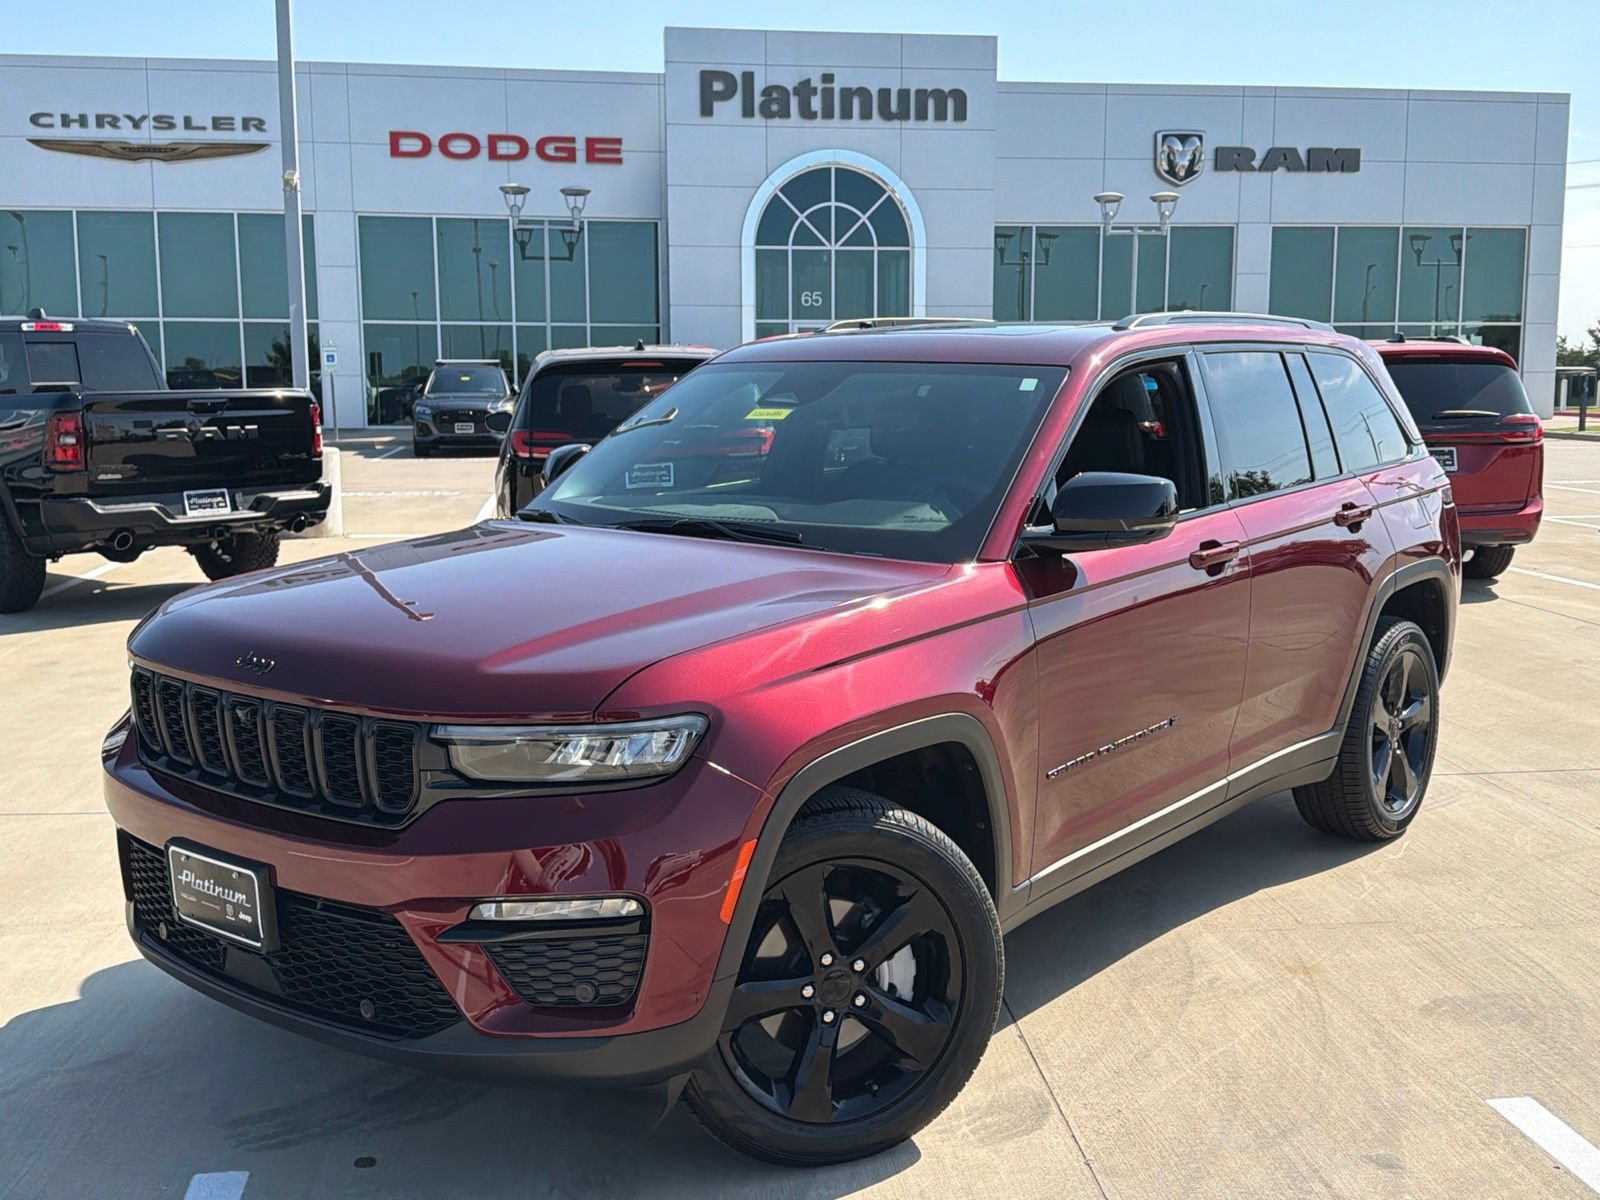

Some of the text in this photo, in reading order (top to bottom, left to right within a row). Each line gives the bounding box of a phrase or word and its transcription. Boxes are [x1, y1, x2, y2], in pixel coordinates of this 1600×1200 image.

[699, 69, 968, 122] Platinum
[29, 112, 268, 133] CHRYSLER
[389, 130, 623, 165] DODGE
[1214, 146, 1361, 173] RAM
[801, 291, 823, 307] 65
[156, 425, 259, 441] RAM
[235, 649, 275, 676] Jeep
[178, 869, 251, 908] Platinum
